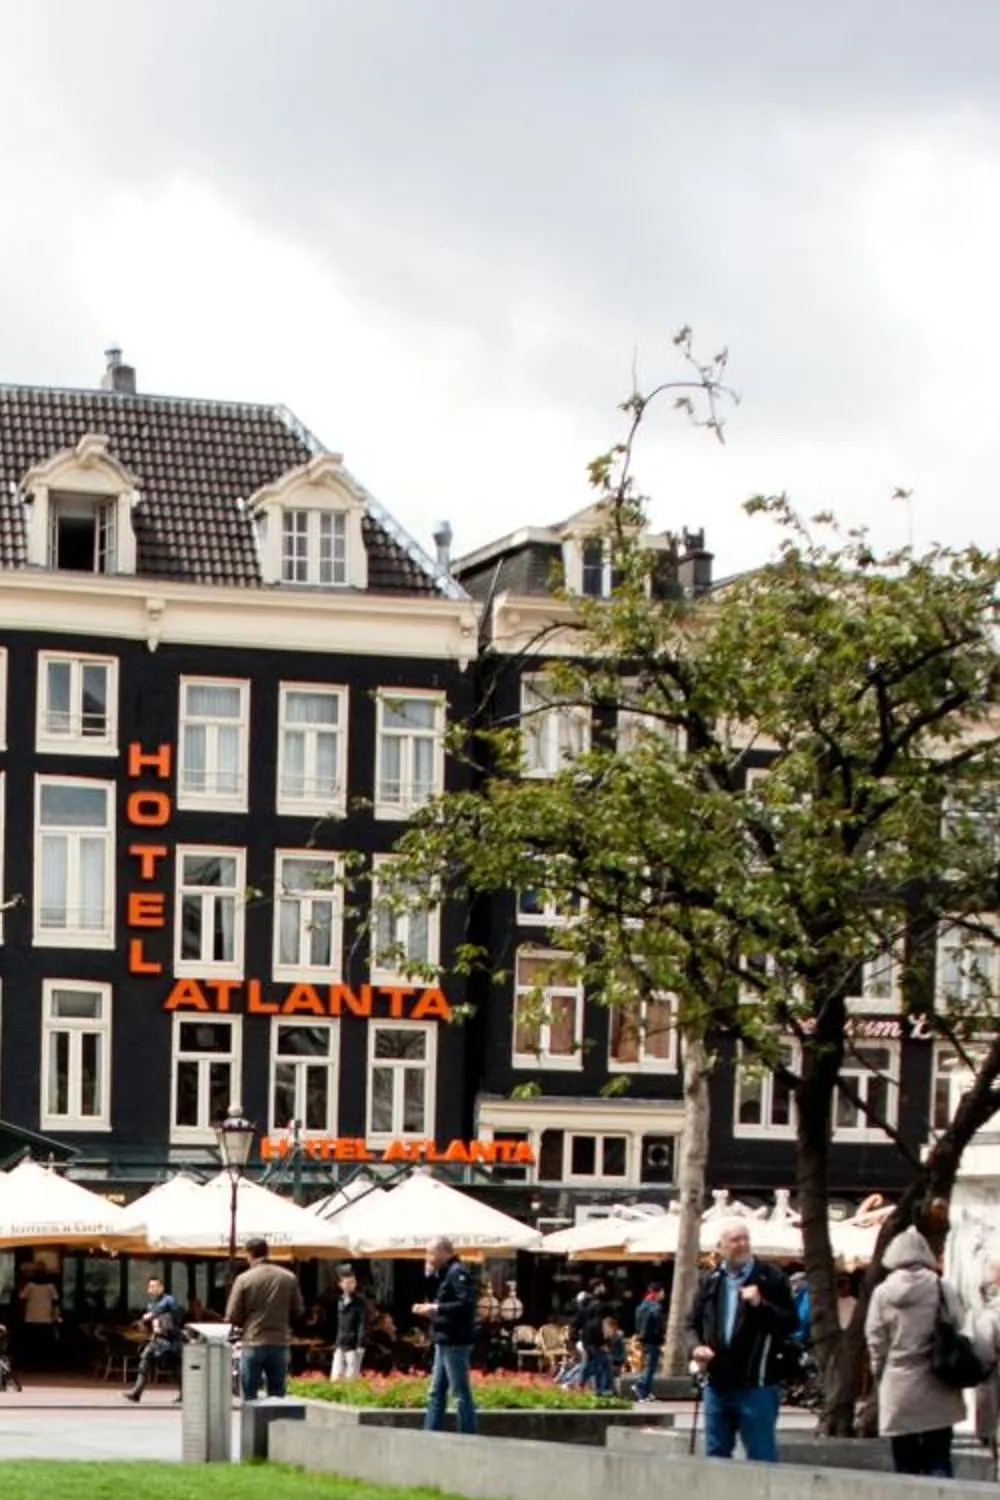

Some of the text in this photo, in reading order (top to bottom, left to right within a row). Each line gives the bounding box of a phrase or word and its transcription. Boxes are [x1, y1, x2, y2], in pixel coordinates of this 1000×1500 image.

[125, 740, 172, 975] HOTEL
[163, 977, 455, 1022] ATLANTA
[381, 1138, 536, 1163] ATLANTA
